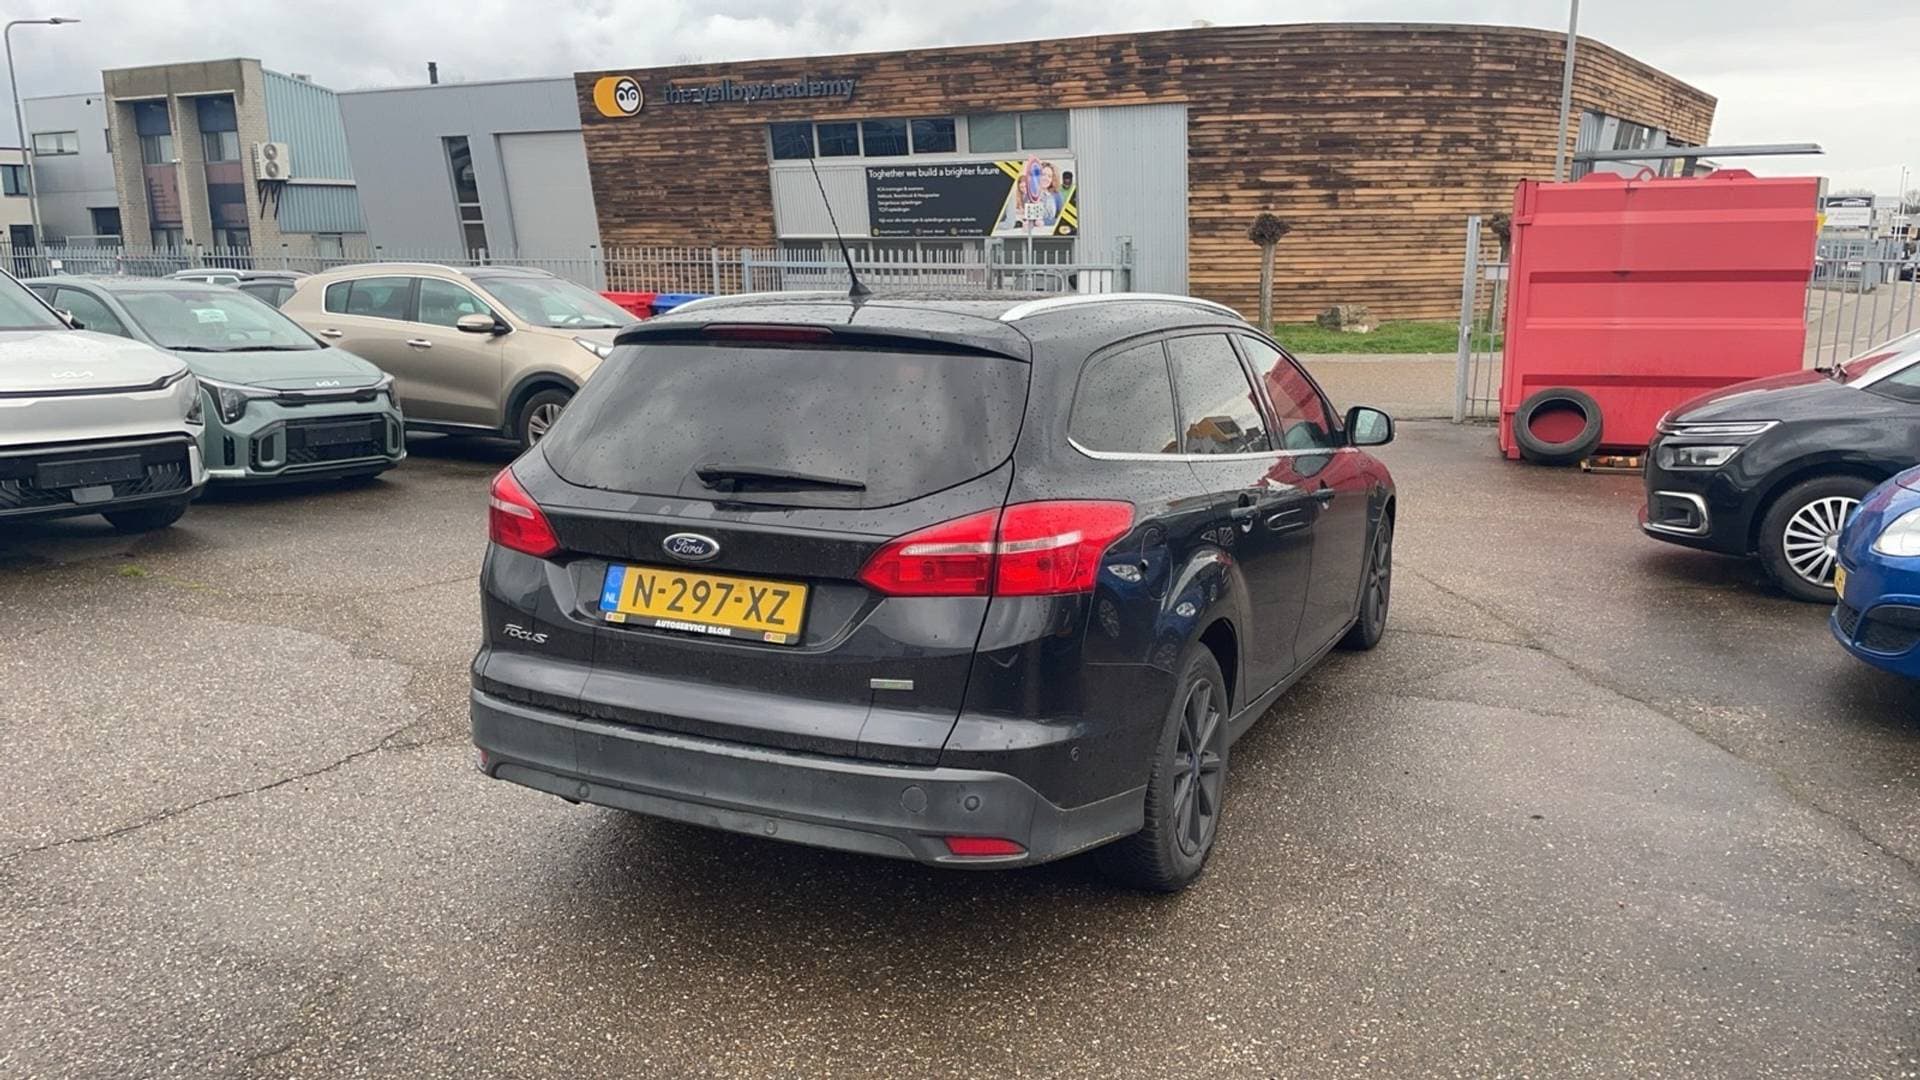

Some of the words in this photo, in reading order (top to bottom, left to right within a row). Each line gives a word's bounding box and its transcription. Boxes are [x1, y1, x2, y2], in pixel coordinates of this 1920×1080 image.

[906, 169, 918, 177] we
[918, 167, 938, 177] build
[939, 169, 944, 177] a
[944, 166, 975, 178] brighter
[976, 164, 1000, 176] future
[673, 537, 705, 555] Ford
[604, 592, 617, 604] NL
[632, 574, 790, 626] N-297-XZ
[655, 618, 706, 633] AUTOSERVICE
[707, 625, 731, 637] BLOM
